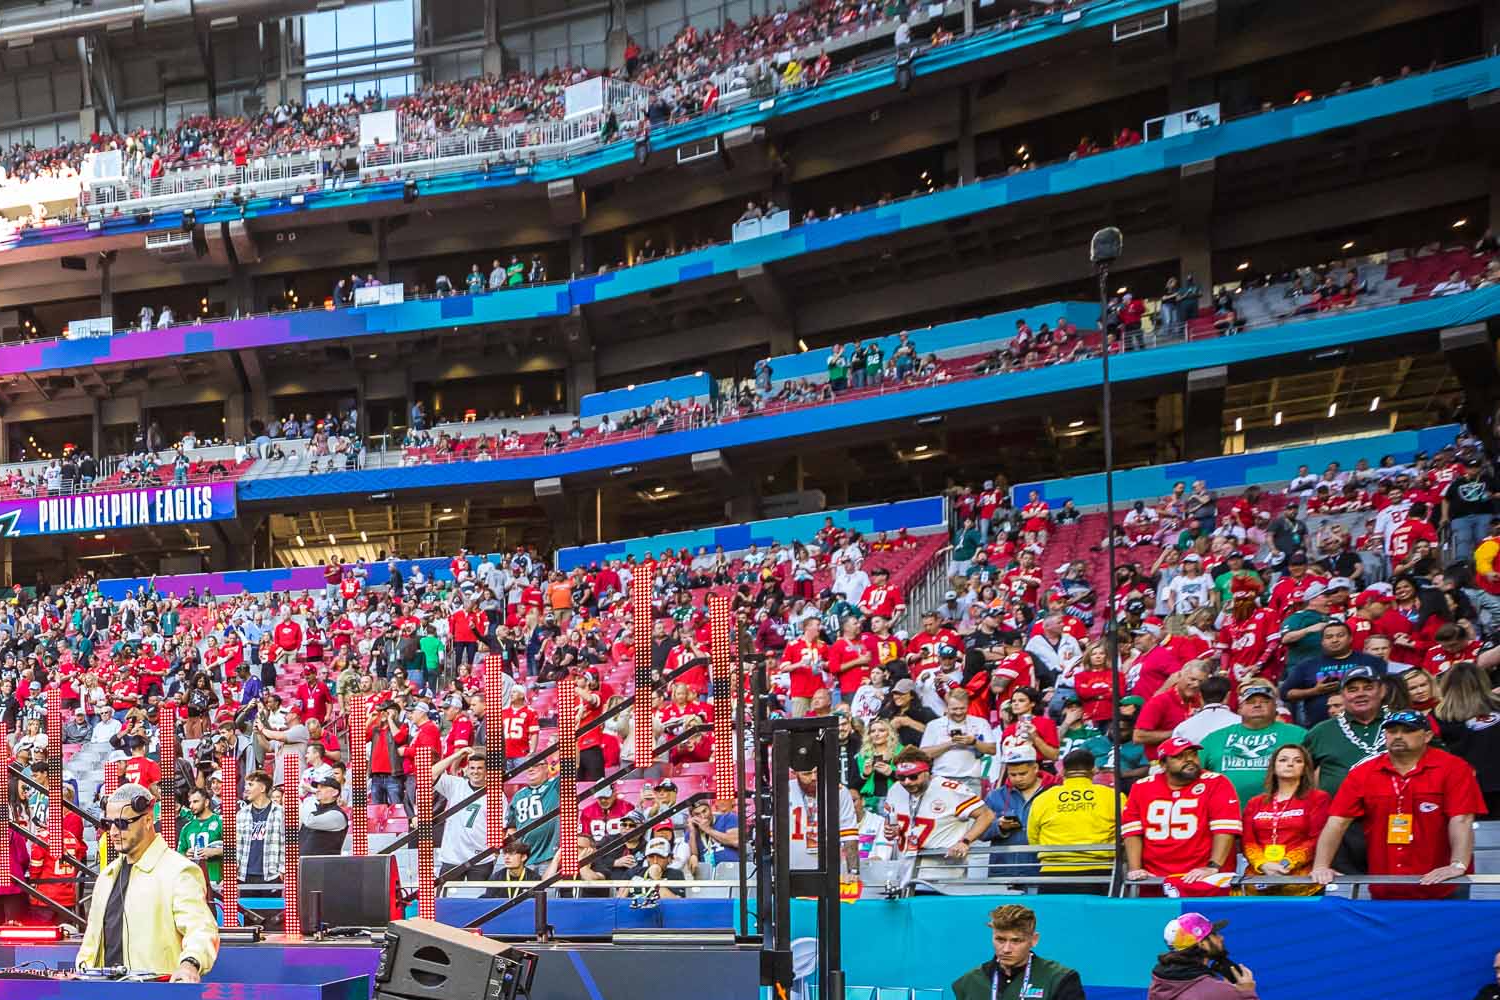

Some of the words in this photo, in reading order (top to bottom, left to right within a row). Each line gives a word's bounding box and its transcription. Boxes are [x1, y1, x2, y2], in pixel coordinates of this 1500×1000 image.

[38, 490, 150, 532] PHILADELPHIA
[155, 486, 213, 523] EAGLES
[1226, 733, 1277, 747] EAGLES
[516, 796, 544, 823] 86
[1058, 790, 1094, 803] CSC
[464, 803, 481, 829] 7
[1145, 798, 1199, 840] 95
